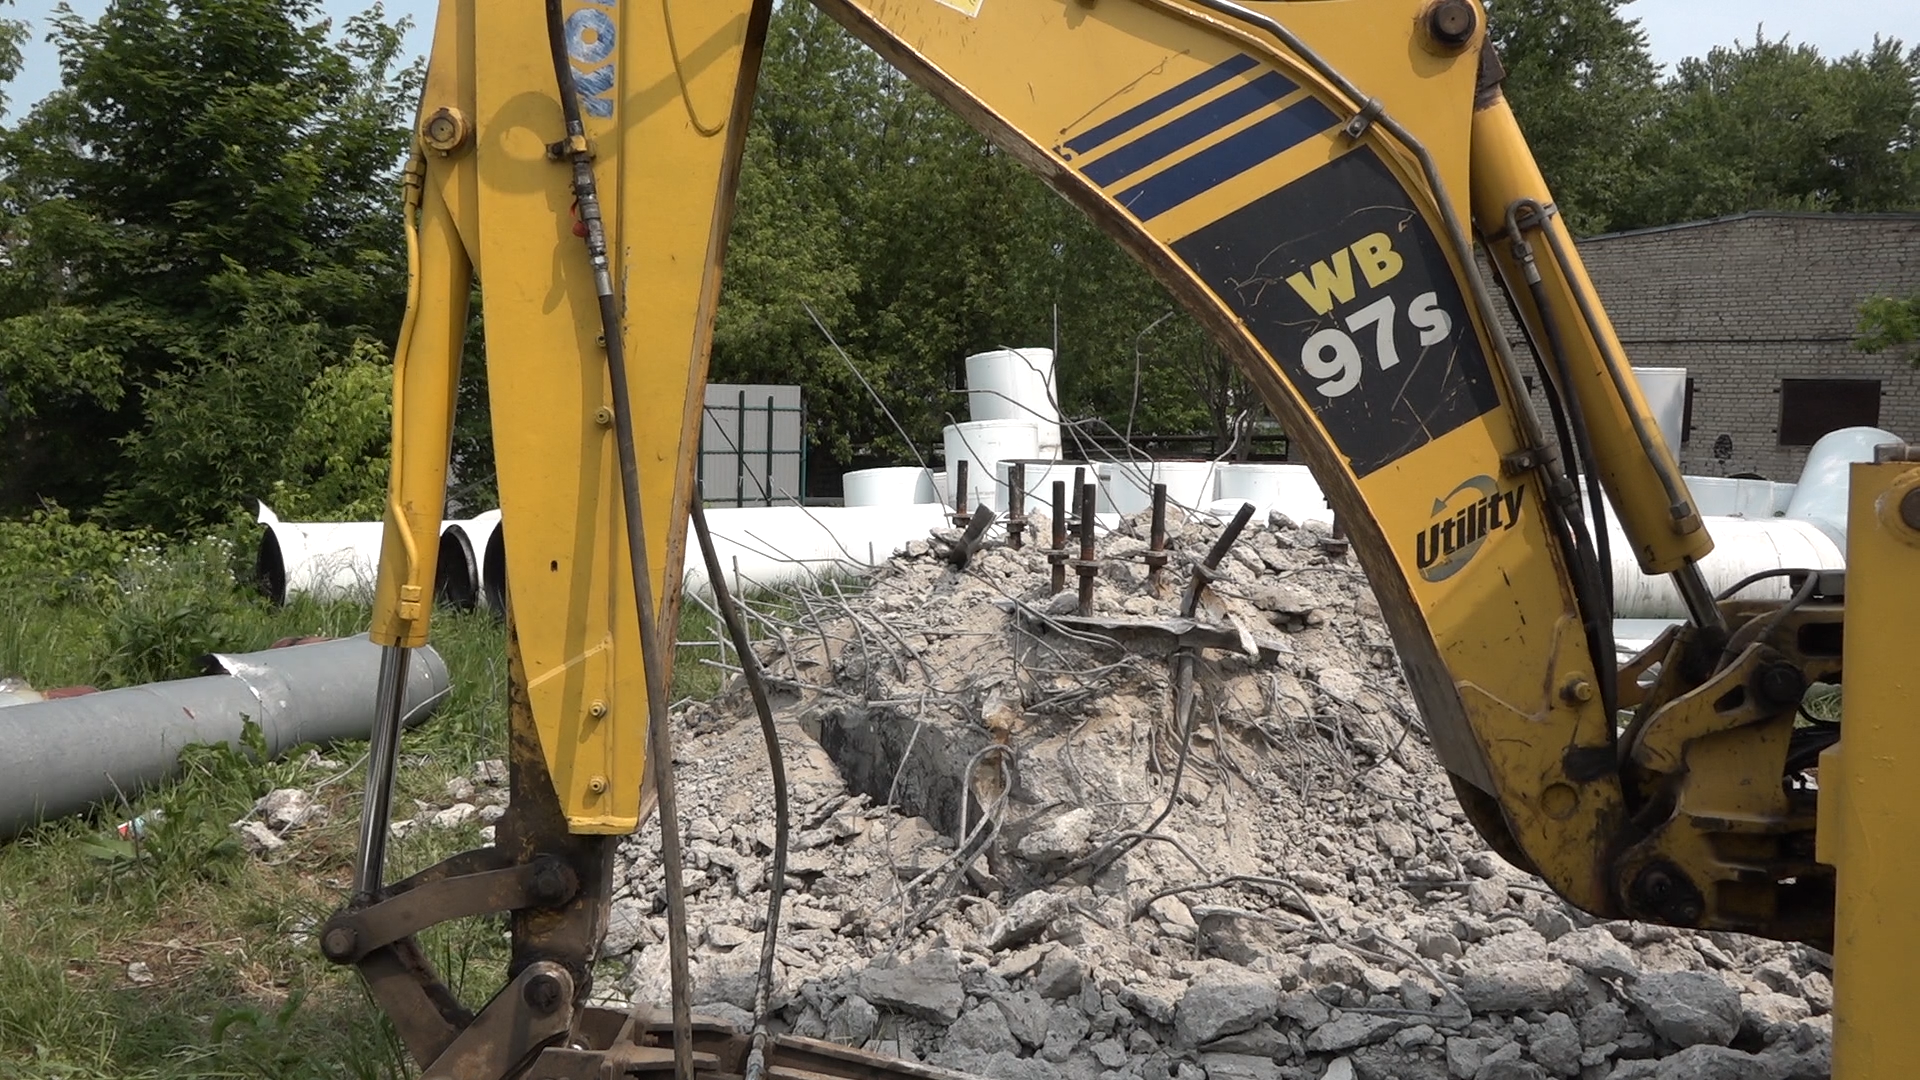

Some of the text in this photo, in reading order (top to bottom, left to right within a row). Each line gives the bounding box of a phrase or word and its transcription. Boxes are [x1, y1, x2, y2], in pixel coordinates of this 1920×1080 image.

[565, 0, 616, 118] KO
[1286, 232, 1403, 315] WB
[1417, 484, 1525, 570] Utility
